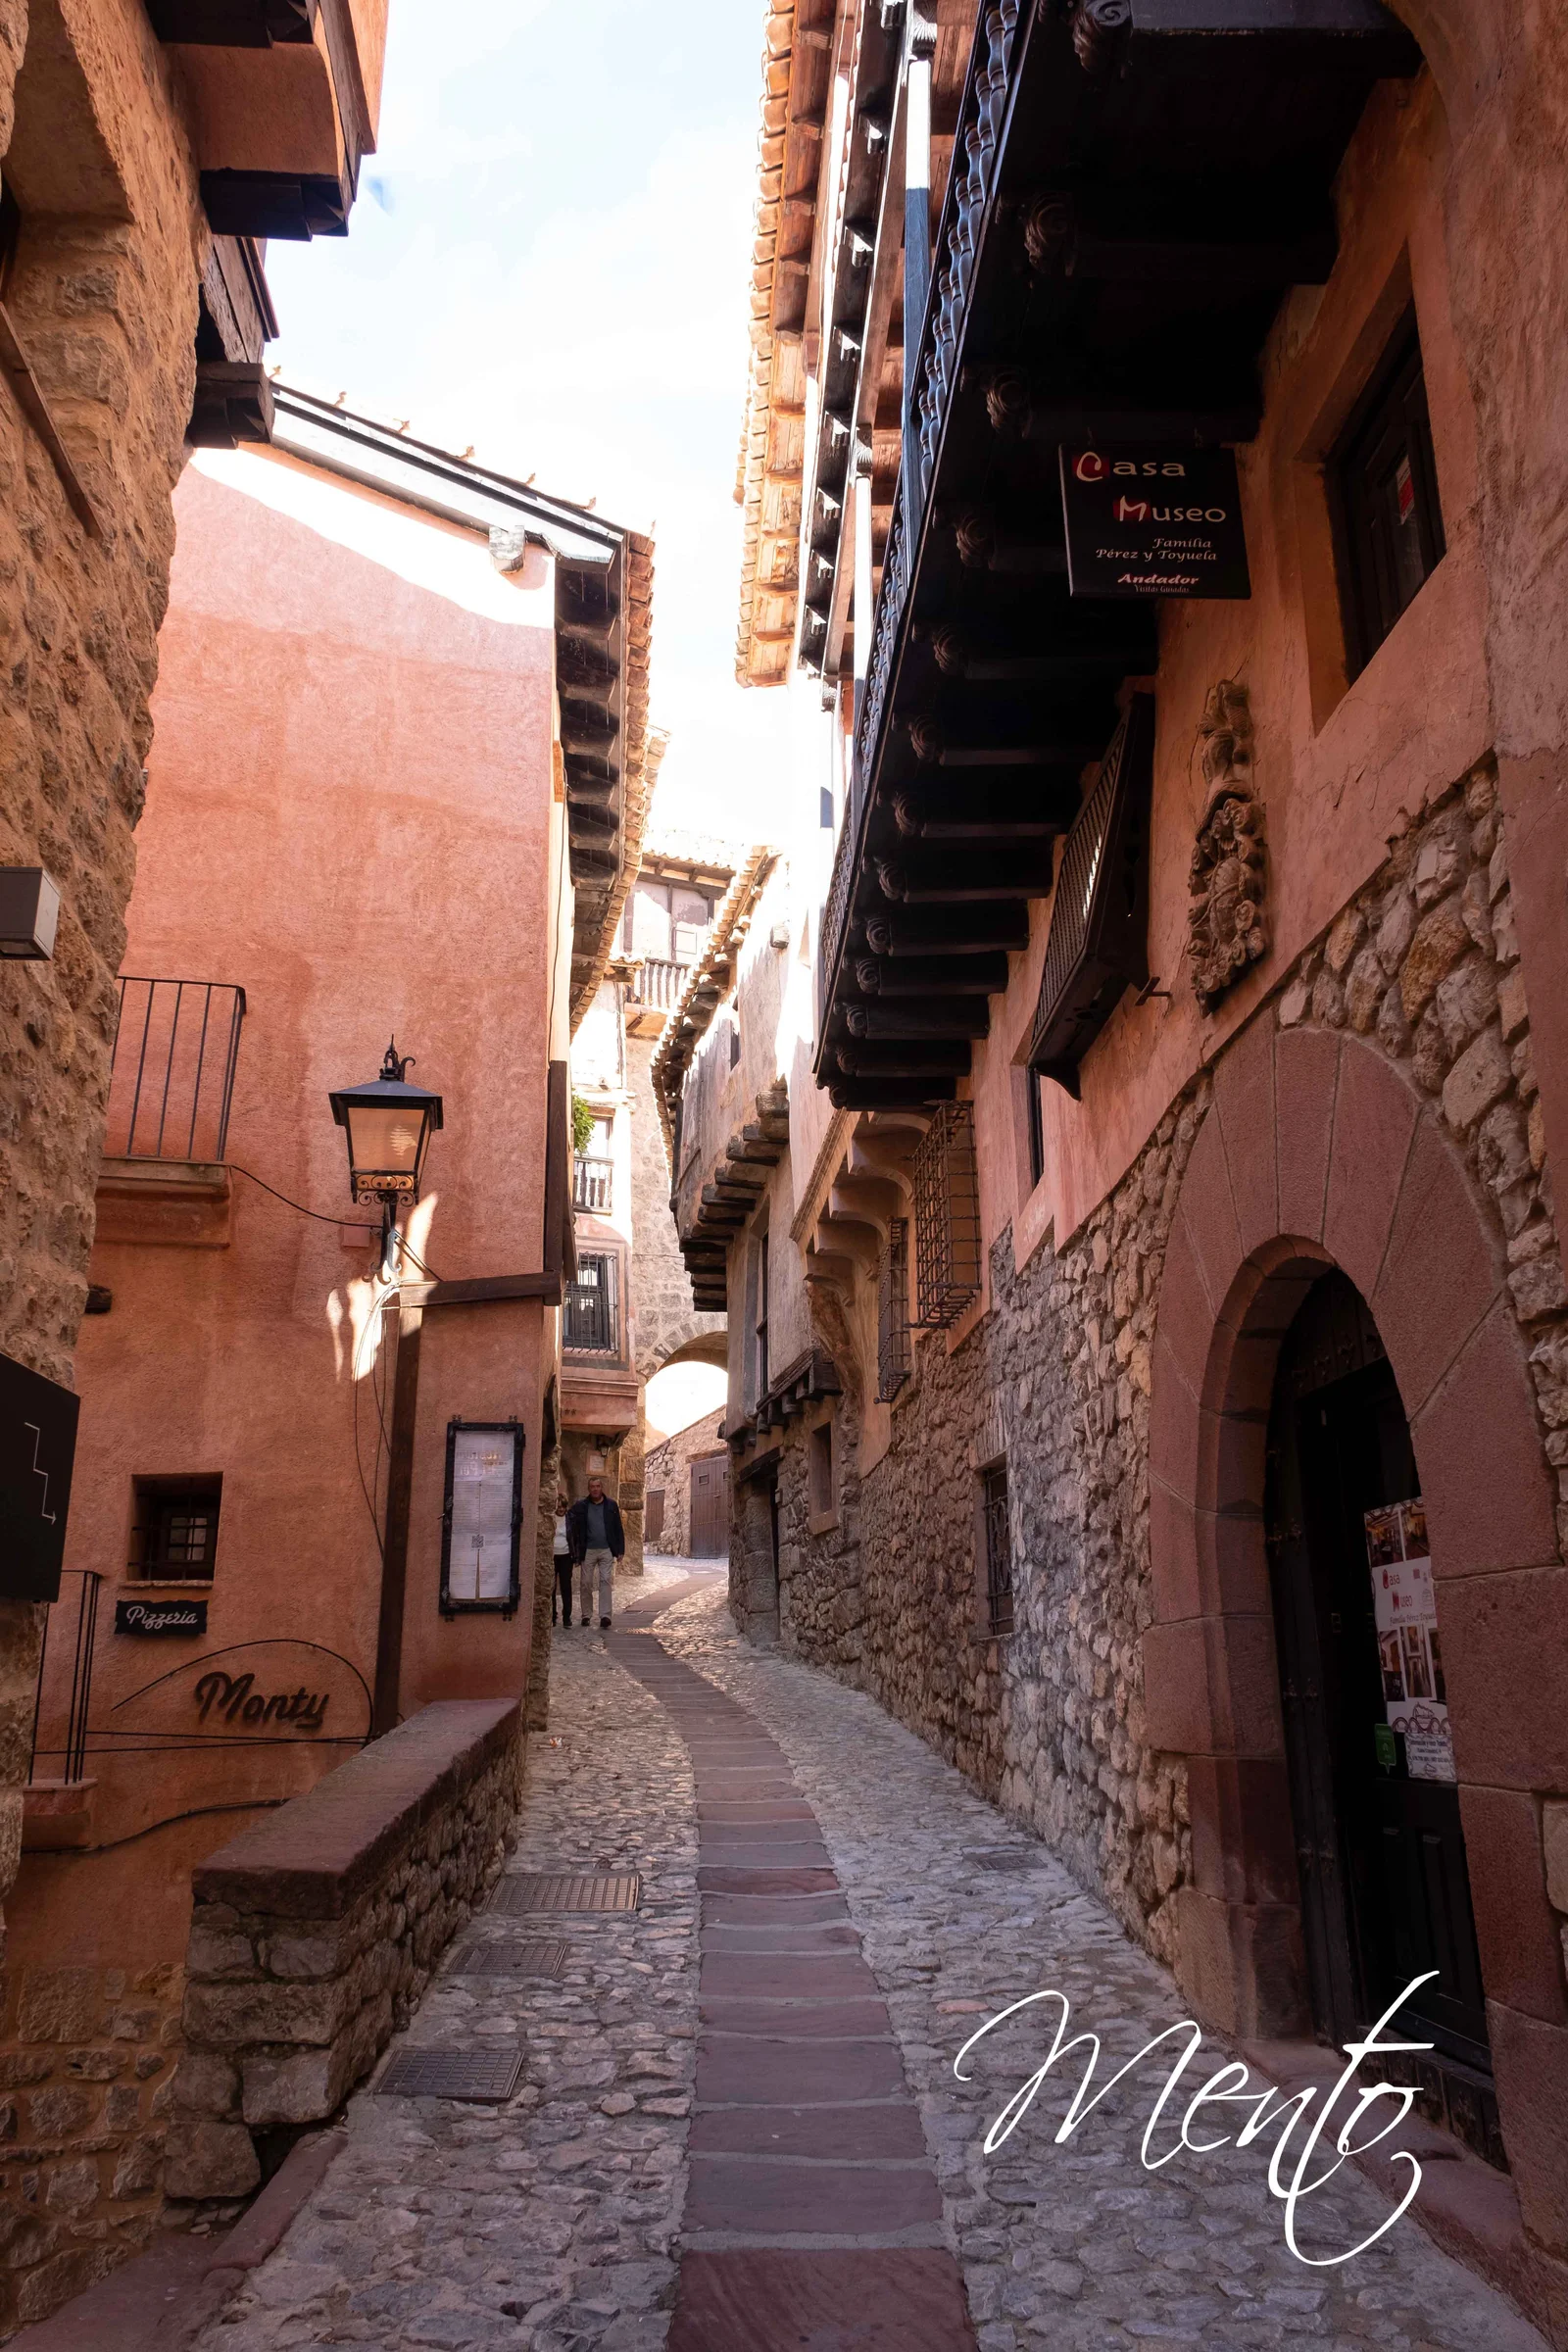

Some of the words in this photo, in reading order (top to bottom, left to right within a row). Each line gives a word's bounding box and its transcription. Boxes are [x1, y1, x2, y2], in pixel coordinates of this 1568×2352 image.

[1076, 452, 1186, 482] Casa
[1119, 495, 1227, 522] Museo
[1152, 538, 1211, 549] Familia
[1096, 549, 1139, 559] Pérez
[1143, 552, 1152, 562] y
[1157, 549, 1217, 563] Toyuela
[1117, 573, 1200, 584] Andador
[1382, 1569, 1400, 1590] Casa
[126, 1605, 198, 1630] Pizzeria
[194, 1671, 329, 1729] Monty
